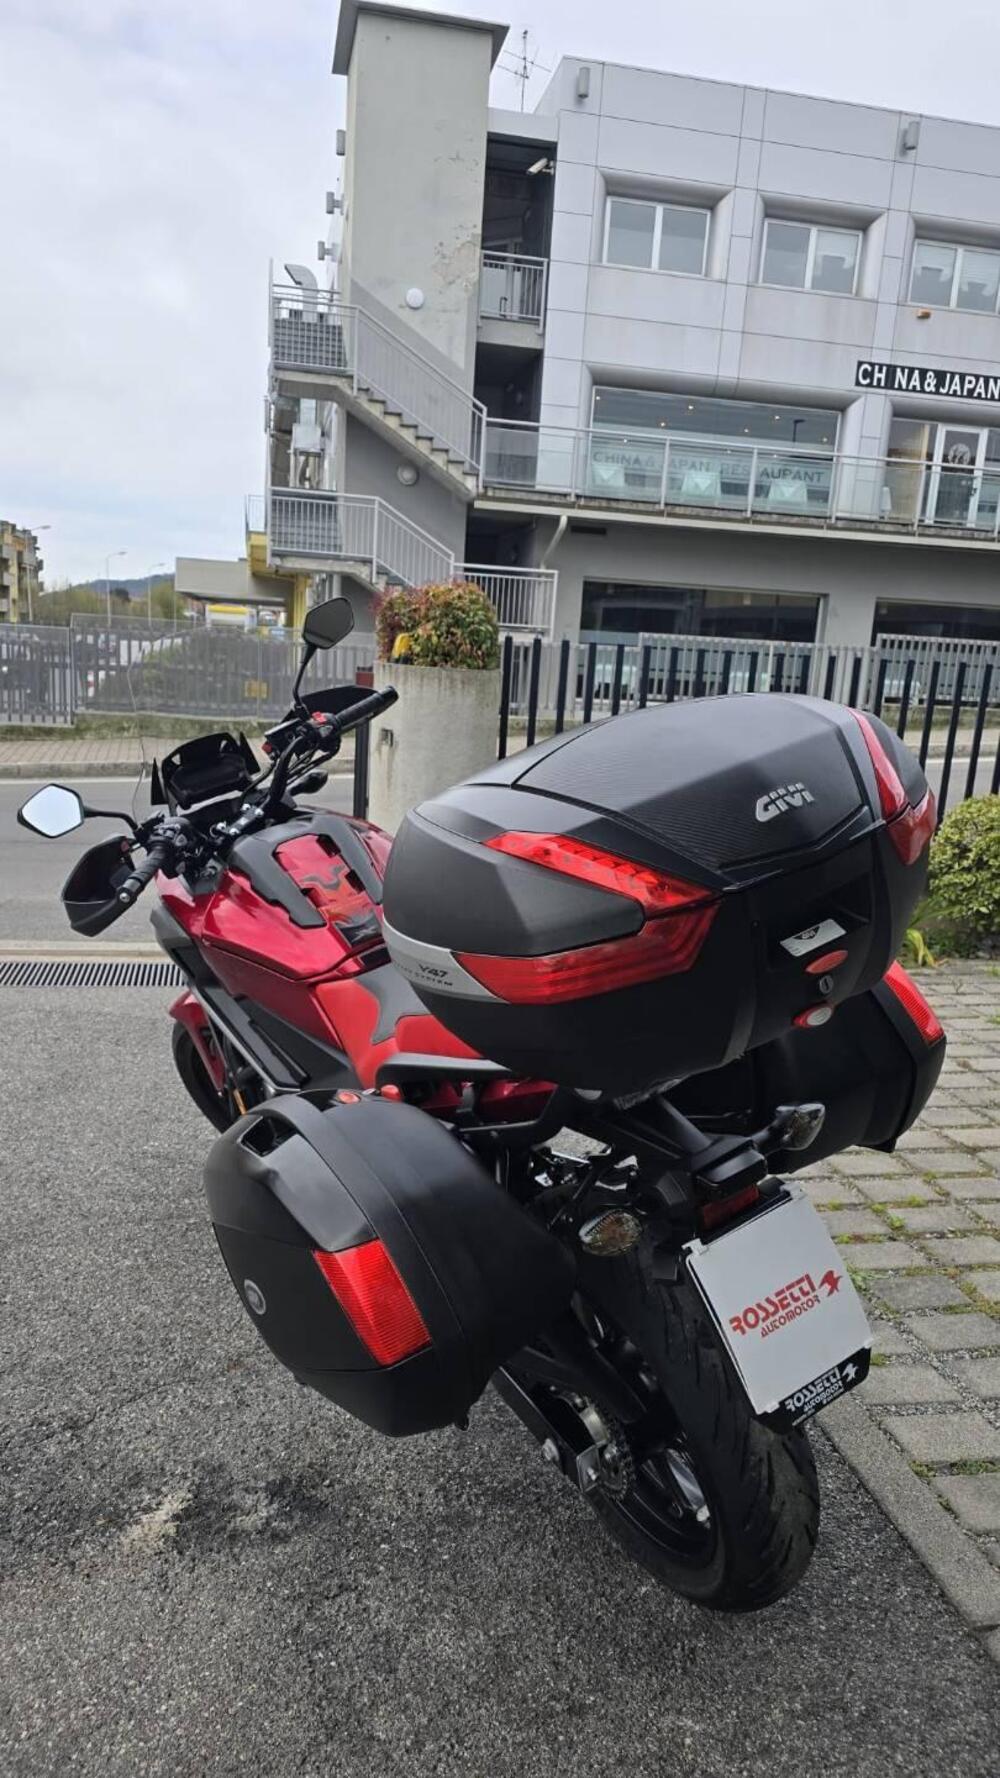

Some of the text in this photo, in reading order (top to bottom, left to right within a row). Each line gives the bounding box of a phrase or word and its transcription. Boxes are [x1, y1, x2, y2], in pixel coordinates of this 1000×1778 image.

[660, 457, 712, 472] APAN
[755, 782, 815, 823] GIVI
[729, 1273, 816, 1336] ROSSETTI
[760, 1294, 821, 1338] AUTOMOTOR
[784, 1366, 841, 1412] ROSSETTI
